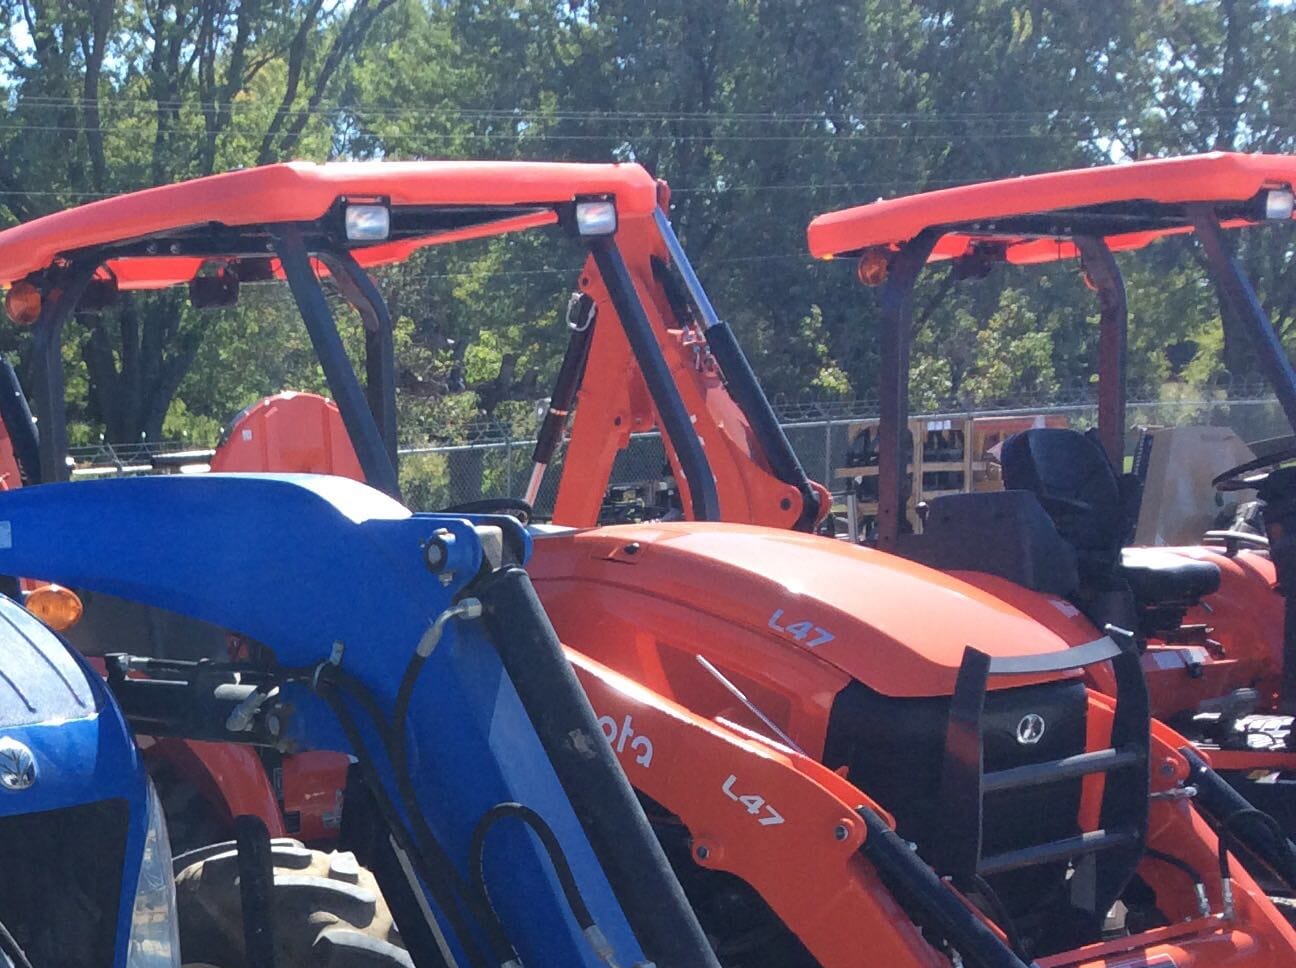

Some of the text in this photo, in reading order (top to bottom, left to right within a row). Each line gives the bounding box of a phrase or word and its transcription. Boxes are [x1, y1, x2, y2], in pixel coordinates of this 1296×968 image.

[768, 609, 836, 648] L47
[597, 713, 653, 768] ota
[722, 774, 785, 826] L47
